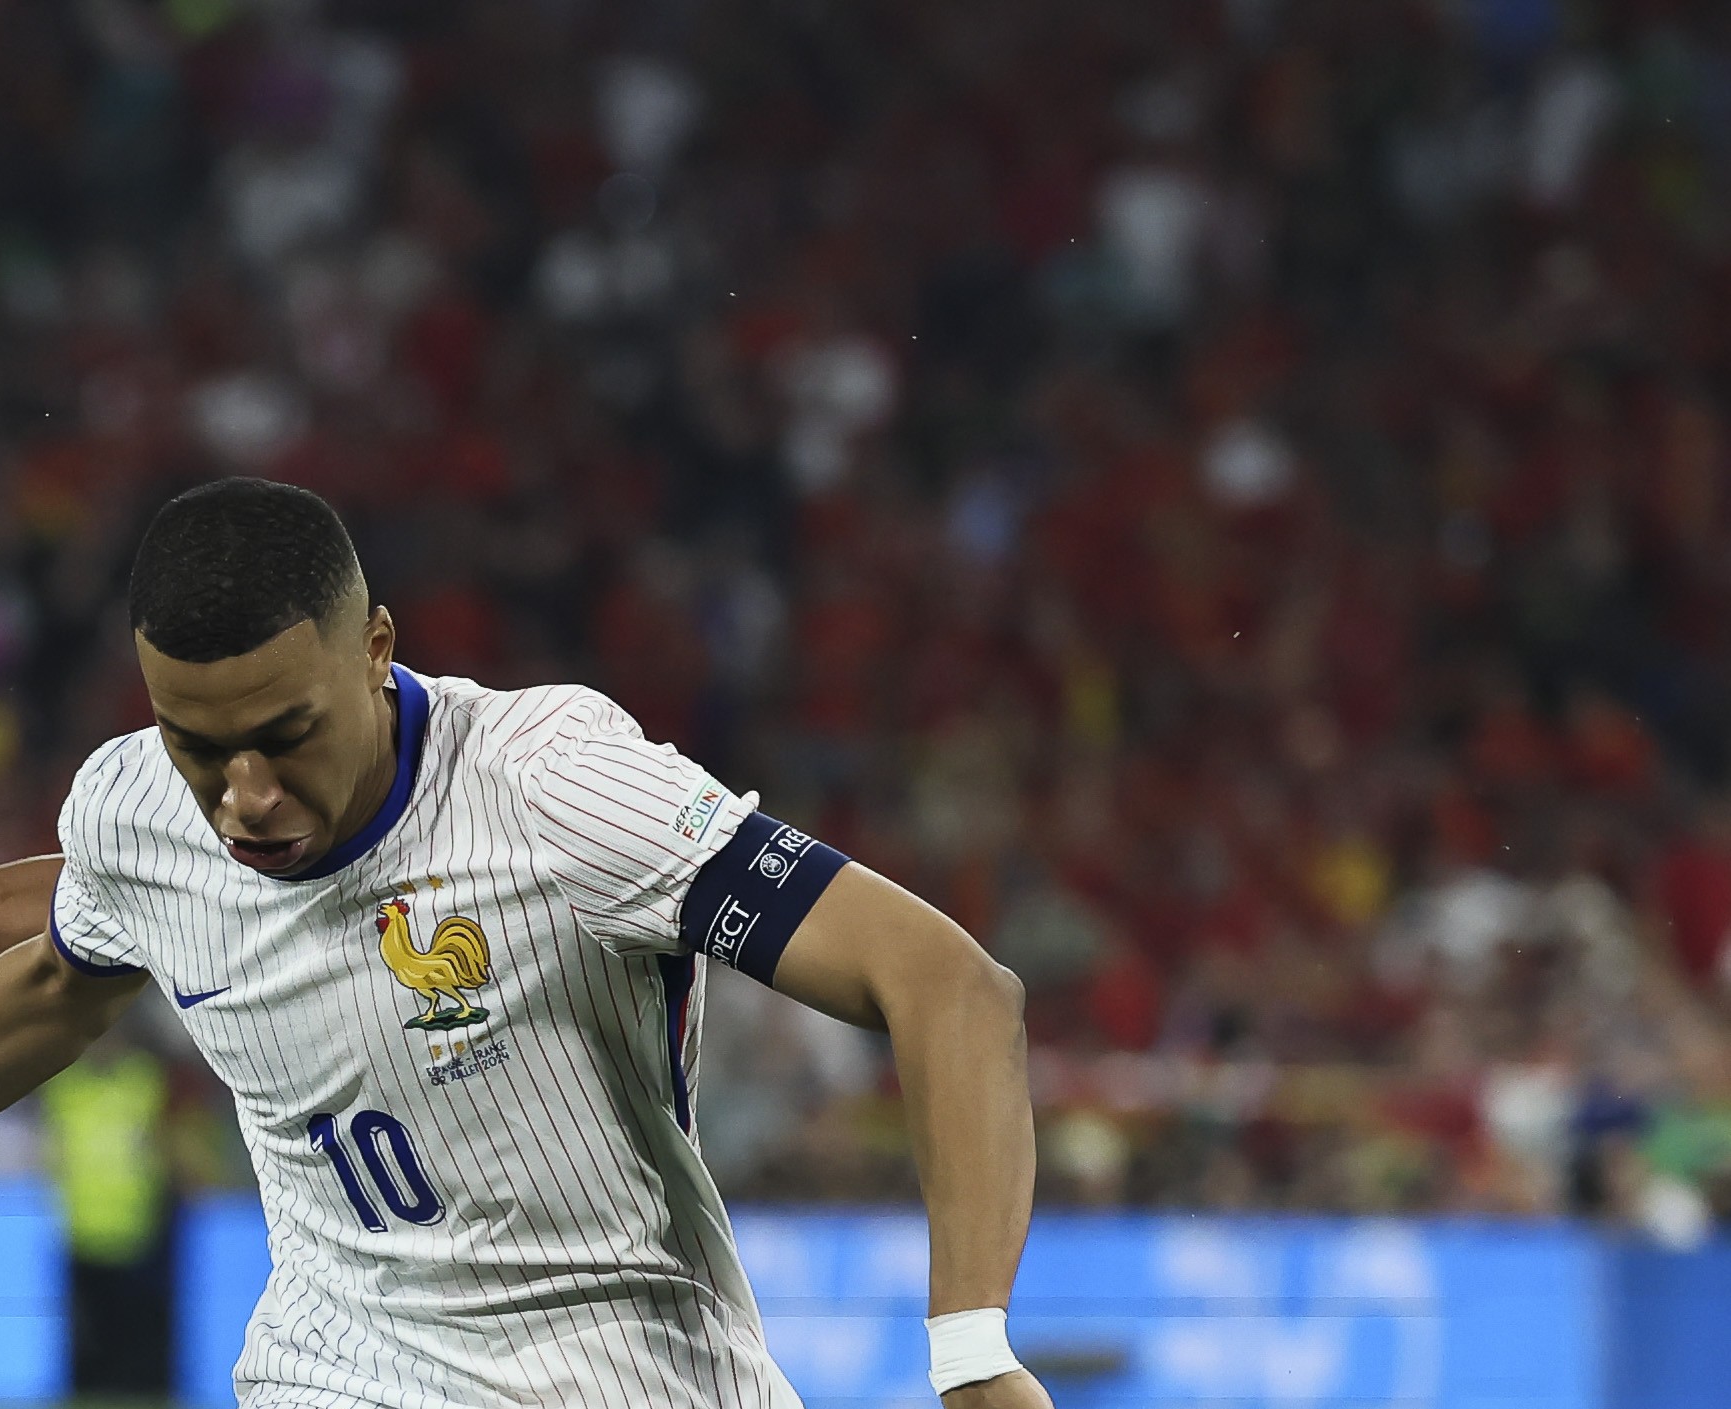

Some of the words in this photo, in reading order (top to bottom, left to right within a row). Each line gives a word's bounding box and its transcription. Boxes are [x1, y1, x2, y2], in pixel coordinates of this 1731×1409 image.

[673, 805, 692, 833] UEFA
[481, 1051, 511, 1071] 2024
[306, 1109, 446, 1233] 10
